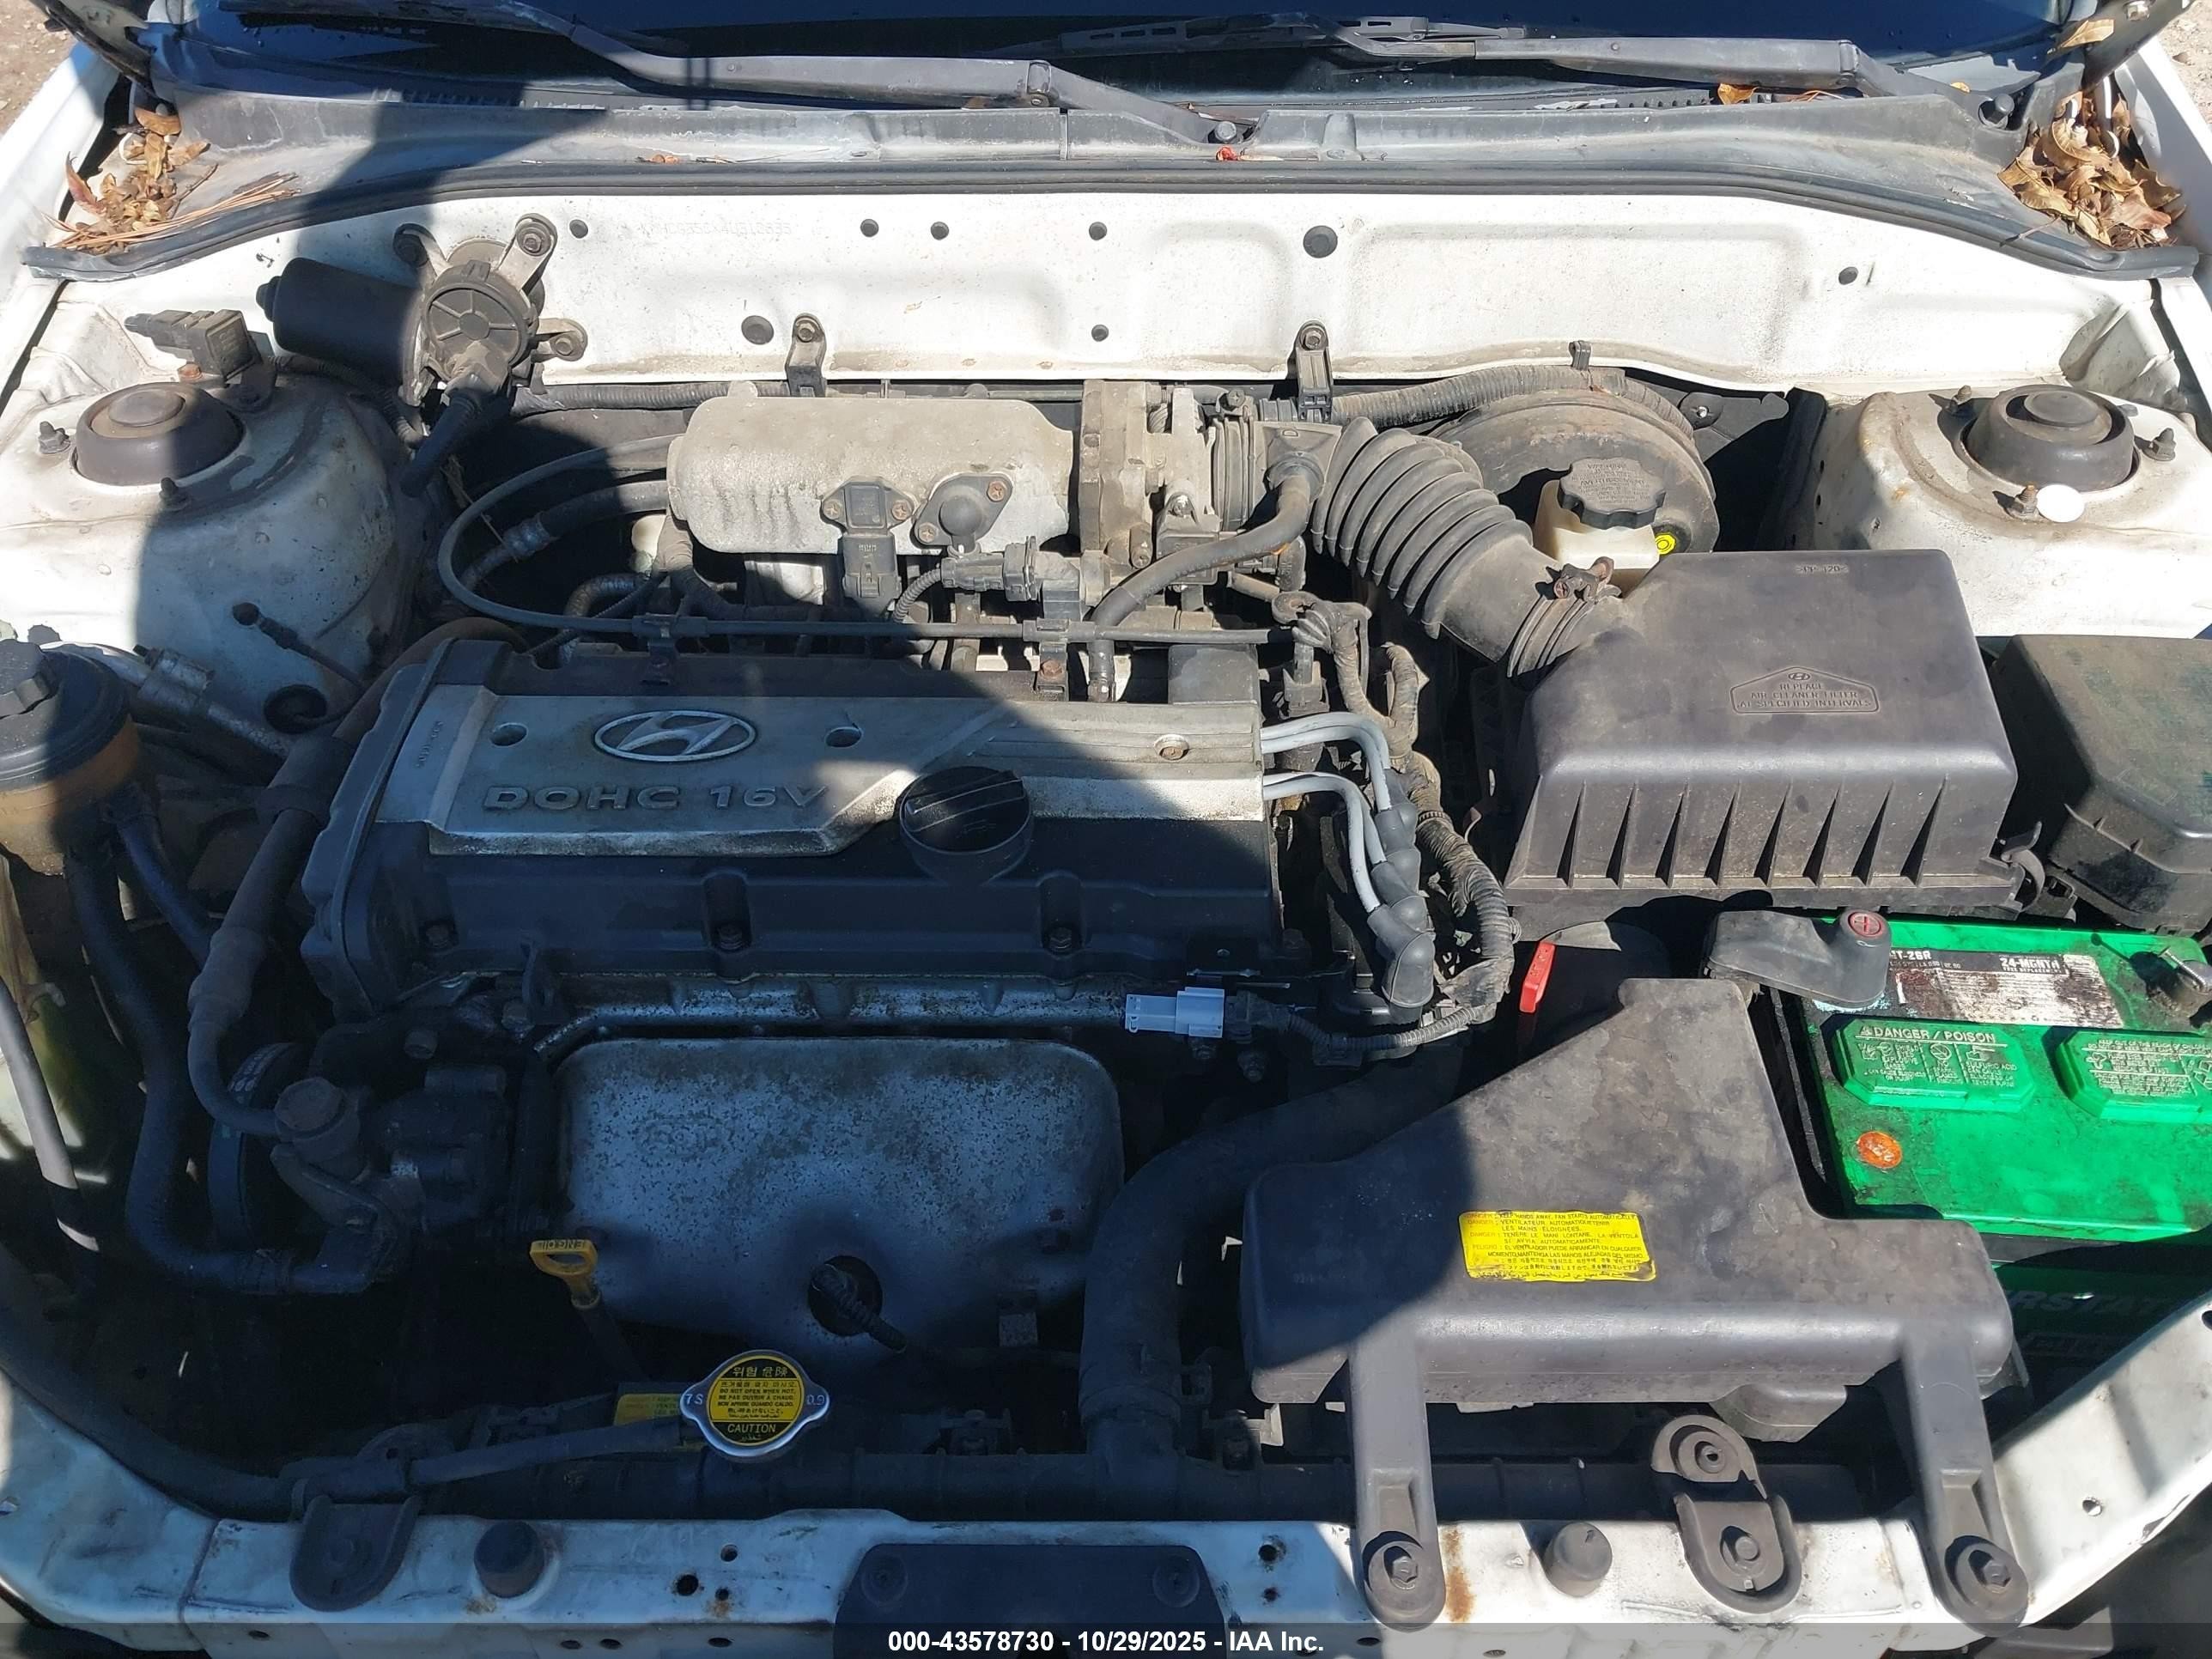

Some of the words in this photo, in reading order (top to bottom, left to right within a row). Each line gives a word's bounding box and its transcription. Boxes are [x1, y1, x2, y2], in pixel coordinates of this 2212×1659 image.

[482, 784, 681, 811] DOHC
[709, 783, 829, 809] 16V
[1999, 957, 2060, 969] 24-MONTH
[1874, 1026, 1930, 1040] DANGER
[1943, 1030, 1996, 1044] POISON
[732, 1366, 757, 1377] 위험
[727, 1423, 776, 1434] CAUTION
